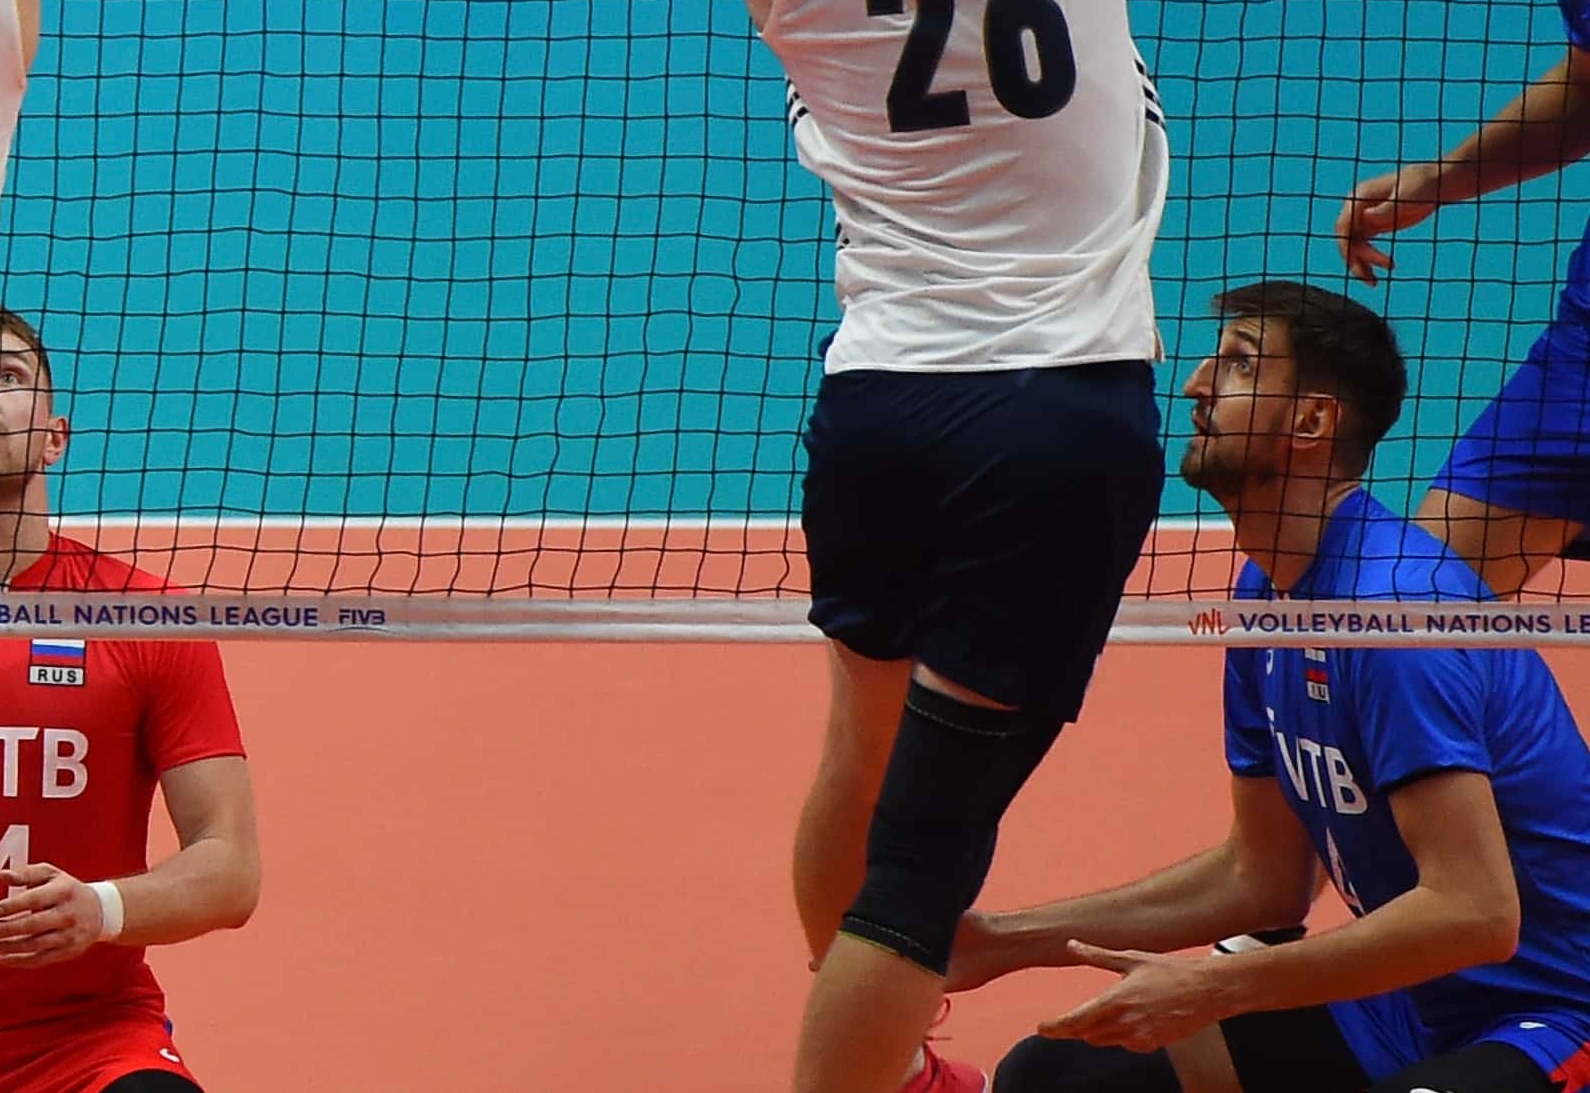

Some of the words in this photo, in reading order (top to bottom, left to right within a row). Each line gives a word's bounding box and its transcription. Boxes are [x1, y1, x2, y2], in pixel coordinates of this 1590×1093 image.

[74, 605, 198, 626] NATIONS
[210, 606, 318, 627] LEAGUE
[1188, 608, 1230, 635] VNL
[1239, 612, 1414, 634] VOLLEYBALL
[1426, 614, 1552, 634] NATIONS
[38, 669, 77, 683] RUS
[1276, 731, 1368, 814] VTB
